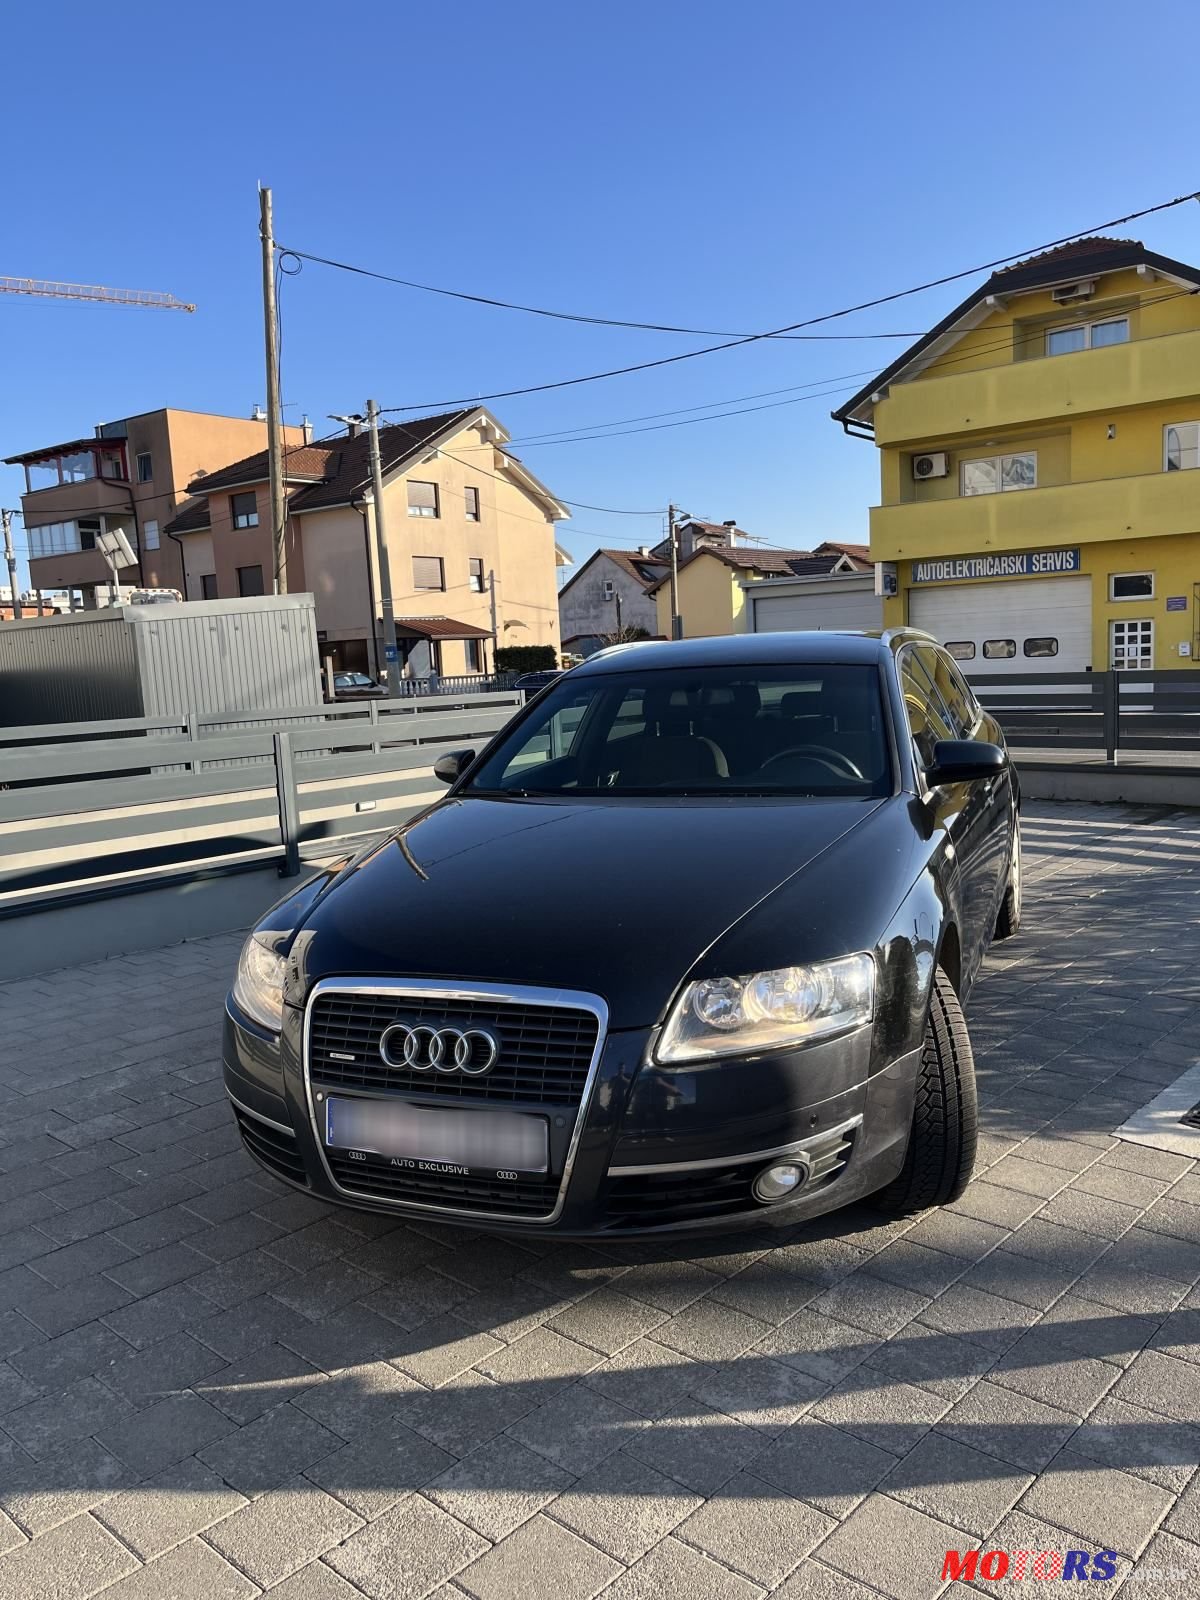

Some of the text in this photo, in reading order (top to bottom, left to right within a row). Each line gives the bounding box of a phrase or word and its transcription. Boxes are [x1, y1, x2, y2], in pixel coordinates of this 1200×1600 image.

[917, 551, 1074, 581] AUTOELEKTRIČARSKI SERVIS
[390, 1158, 470, 1175] AUTO EXCLUSIVE
